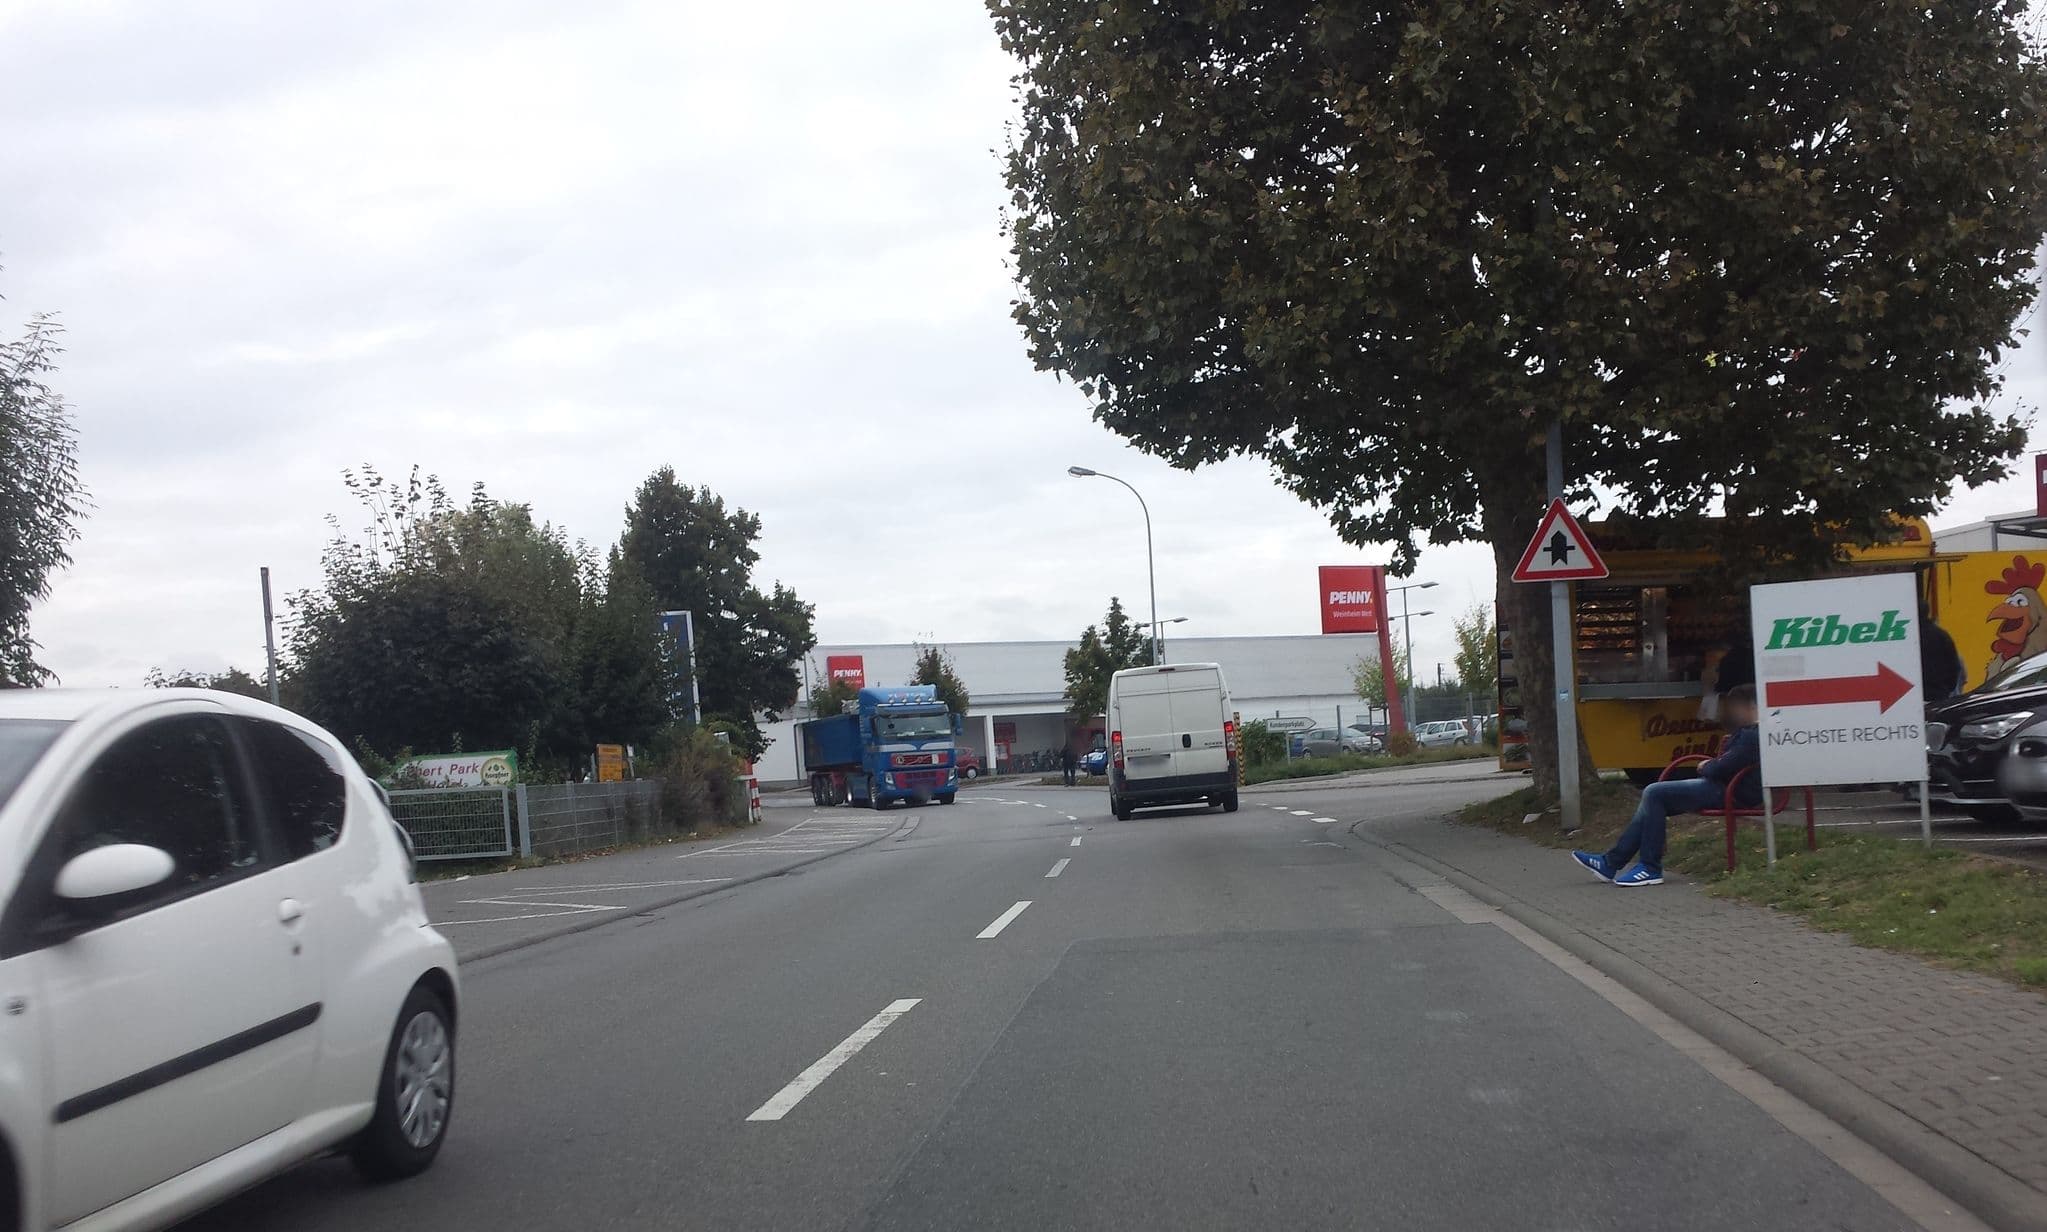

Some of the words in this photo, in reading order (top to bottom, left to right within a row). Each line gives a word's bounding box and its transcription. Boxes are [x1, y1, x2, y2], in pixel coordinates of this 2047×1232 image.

[1764, 610, 1911, 650] Kibek
[1768, 728, 1847, 746] NÄCHSTE
[1852, 724, 1919, 742] RECHTS
[449, 762, 479, 775] Park
